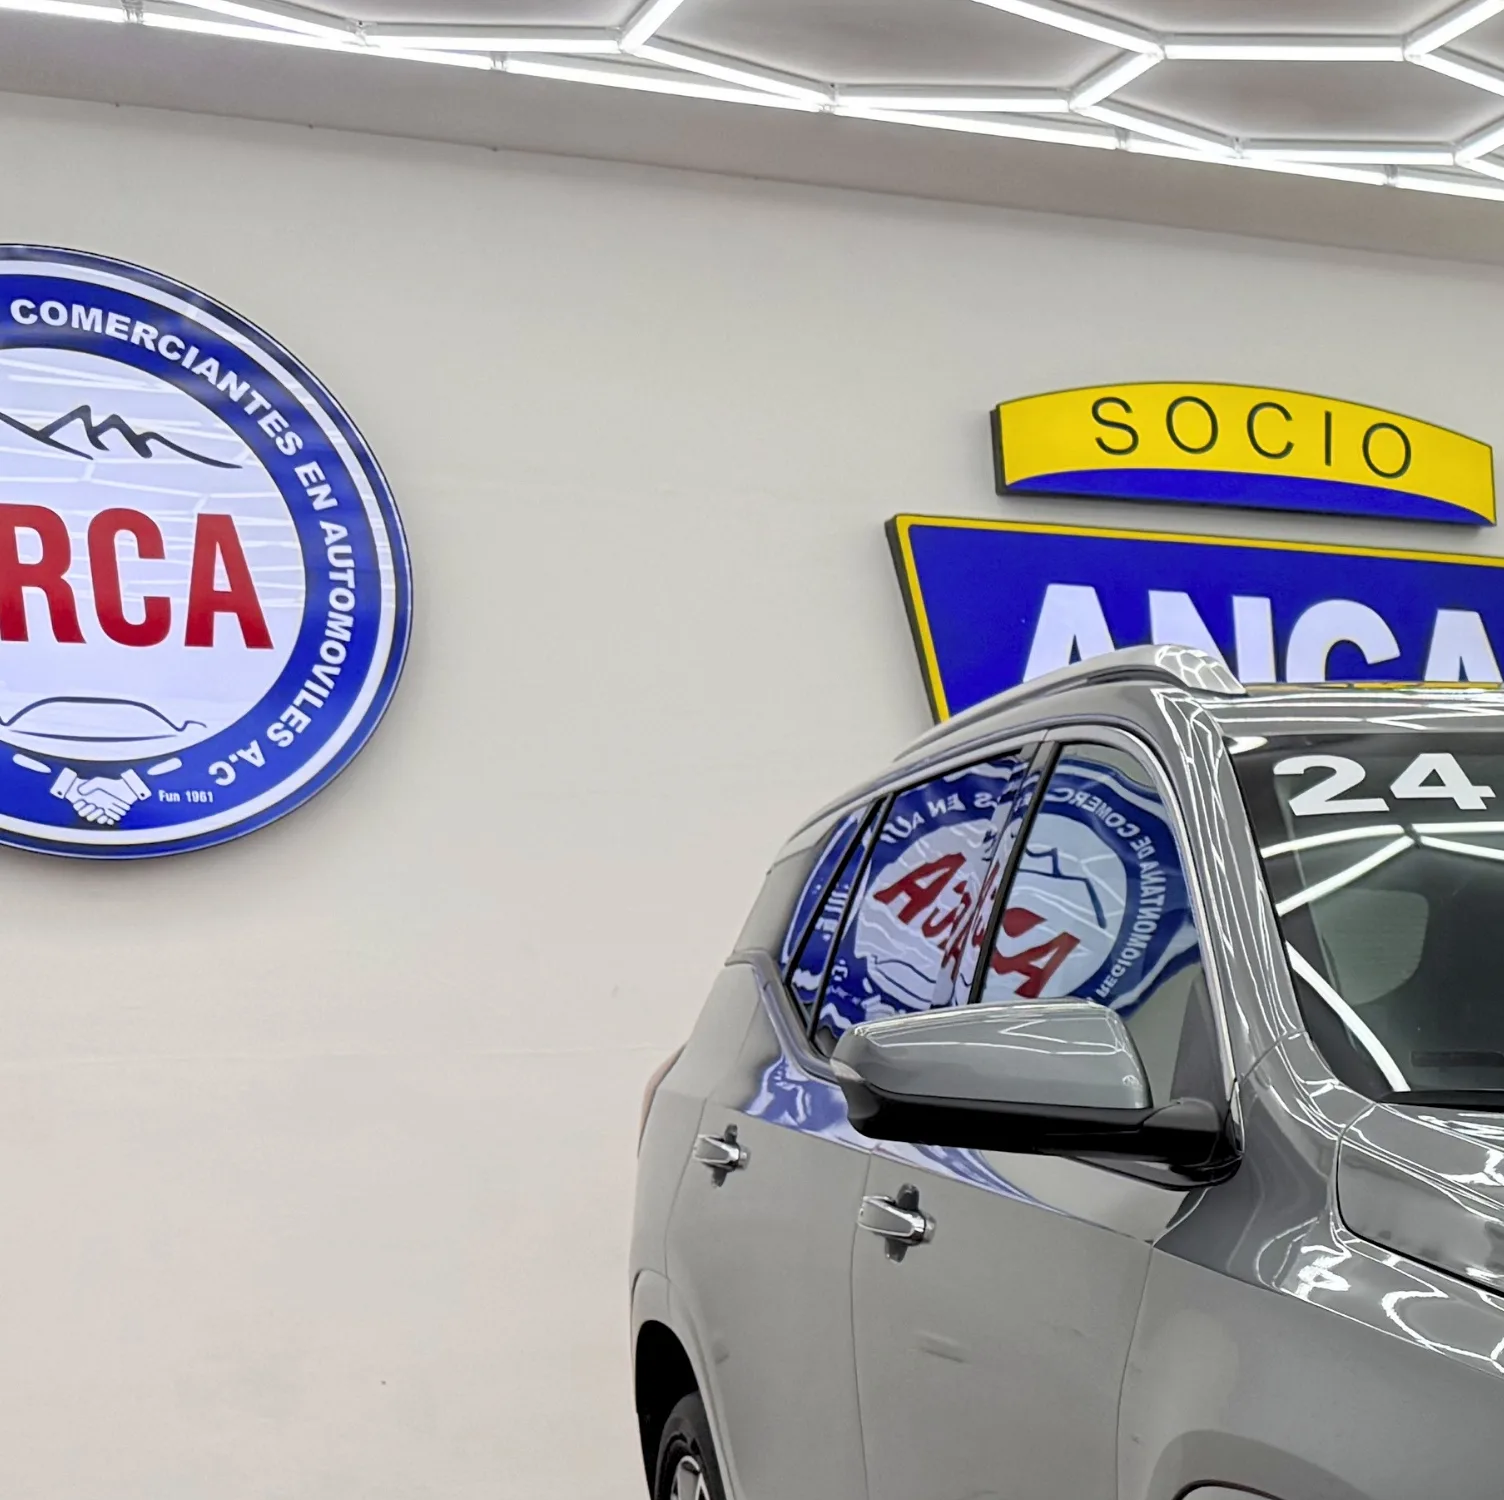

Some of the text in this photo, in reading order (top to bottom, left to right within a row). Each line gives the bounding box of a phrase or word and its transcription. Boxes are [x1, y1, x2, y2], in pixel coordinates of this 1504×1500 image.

[10, 298, 303, 457] COMERCIANTES
[1090, 396, 1413, 480] SOCIO
[294, 460, 338, 513] EN
[266, 520, 357, 749] AUTOMOVILES
[158, 789, 214, 804] Fun 1961
[1273, 752, 1497, 816] 24
